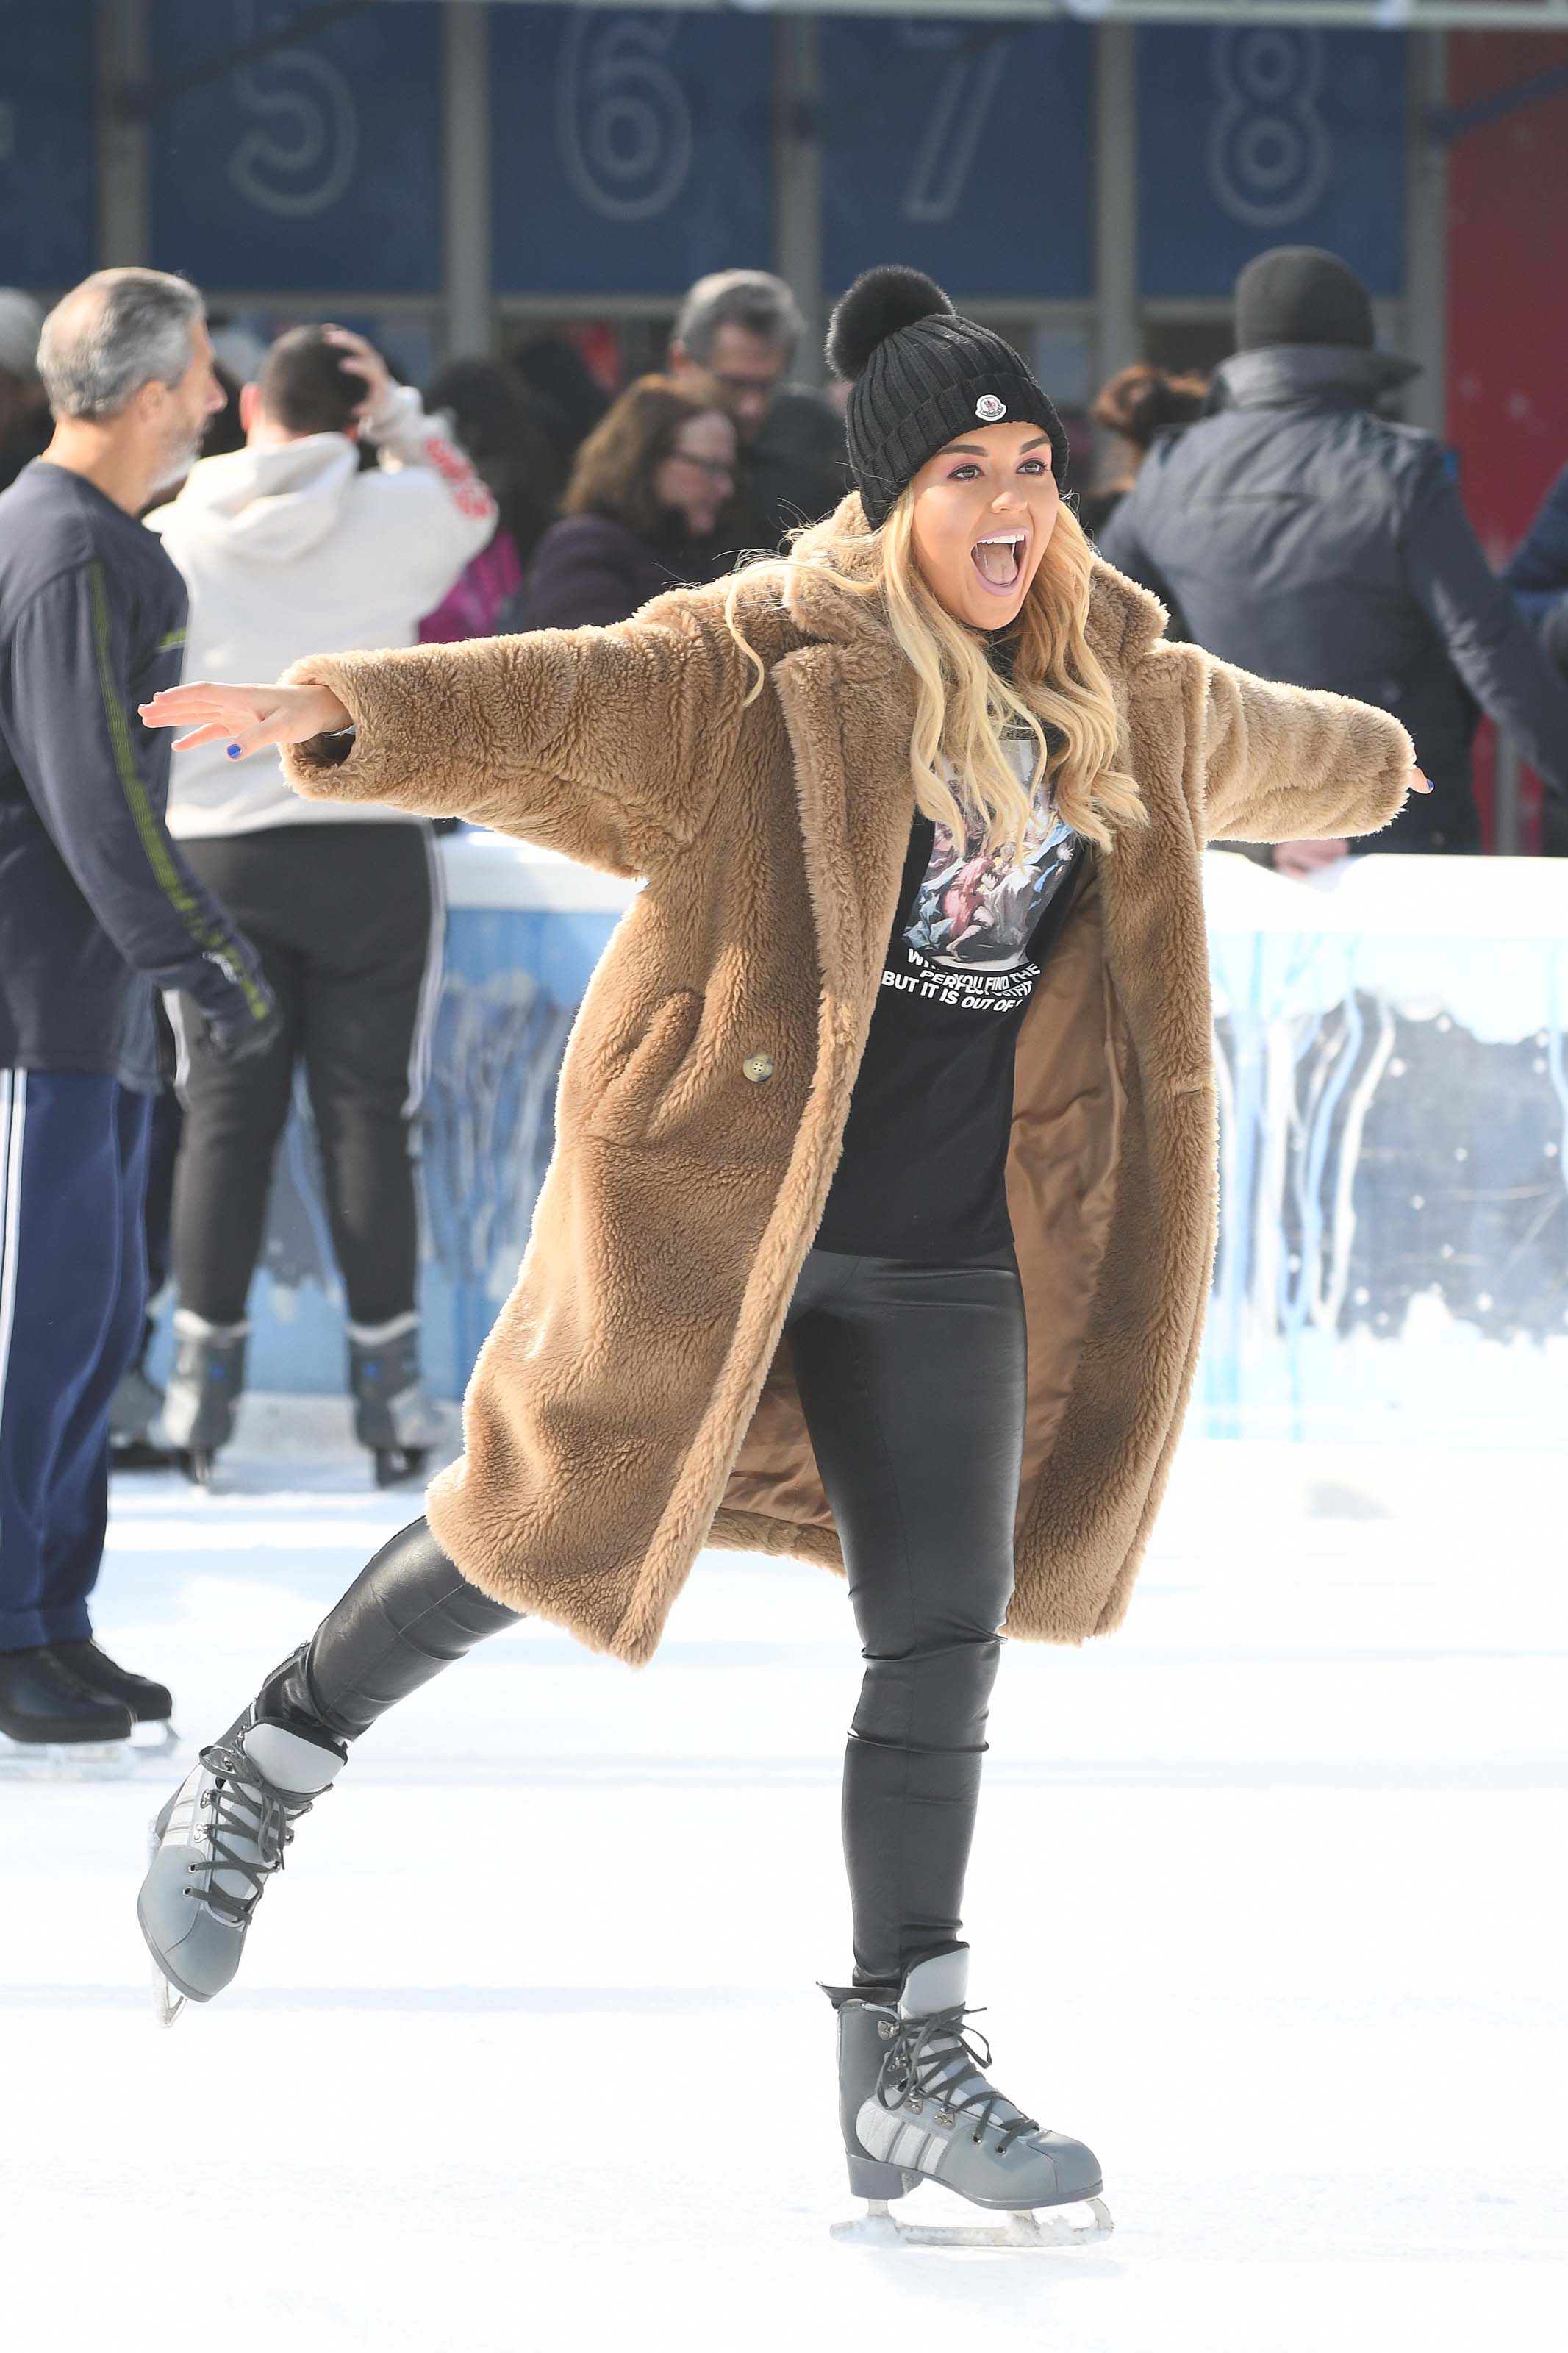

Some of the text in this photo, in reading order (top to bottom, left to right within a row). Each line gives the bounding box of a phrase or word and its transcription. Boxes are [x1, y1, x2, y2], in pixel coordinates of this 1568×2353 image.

[228, 0, 357, 217] 5
[556, 7, 693, 222] 6
[895, 22, 1010, 222] 7
[1206, 28, 1329, 227] 8
[881, 970, 920, 993] BUT
[920, 982, 939, 999] IT
[939, 988, 960, 1004] IS
[961, 996, 995, 1010] OUT
[993, 999, 1016, 1012] OF
[953, 963, 1041, 990] YOU FIND THE
